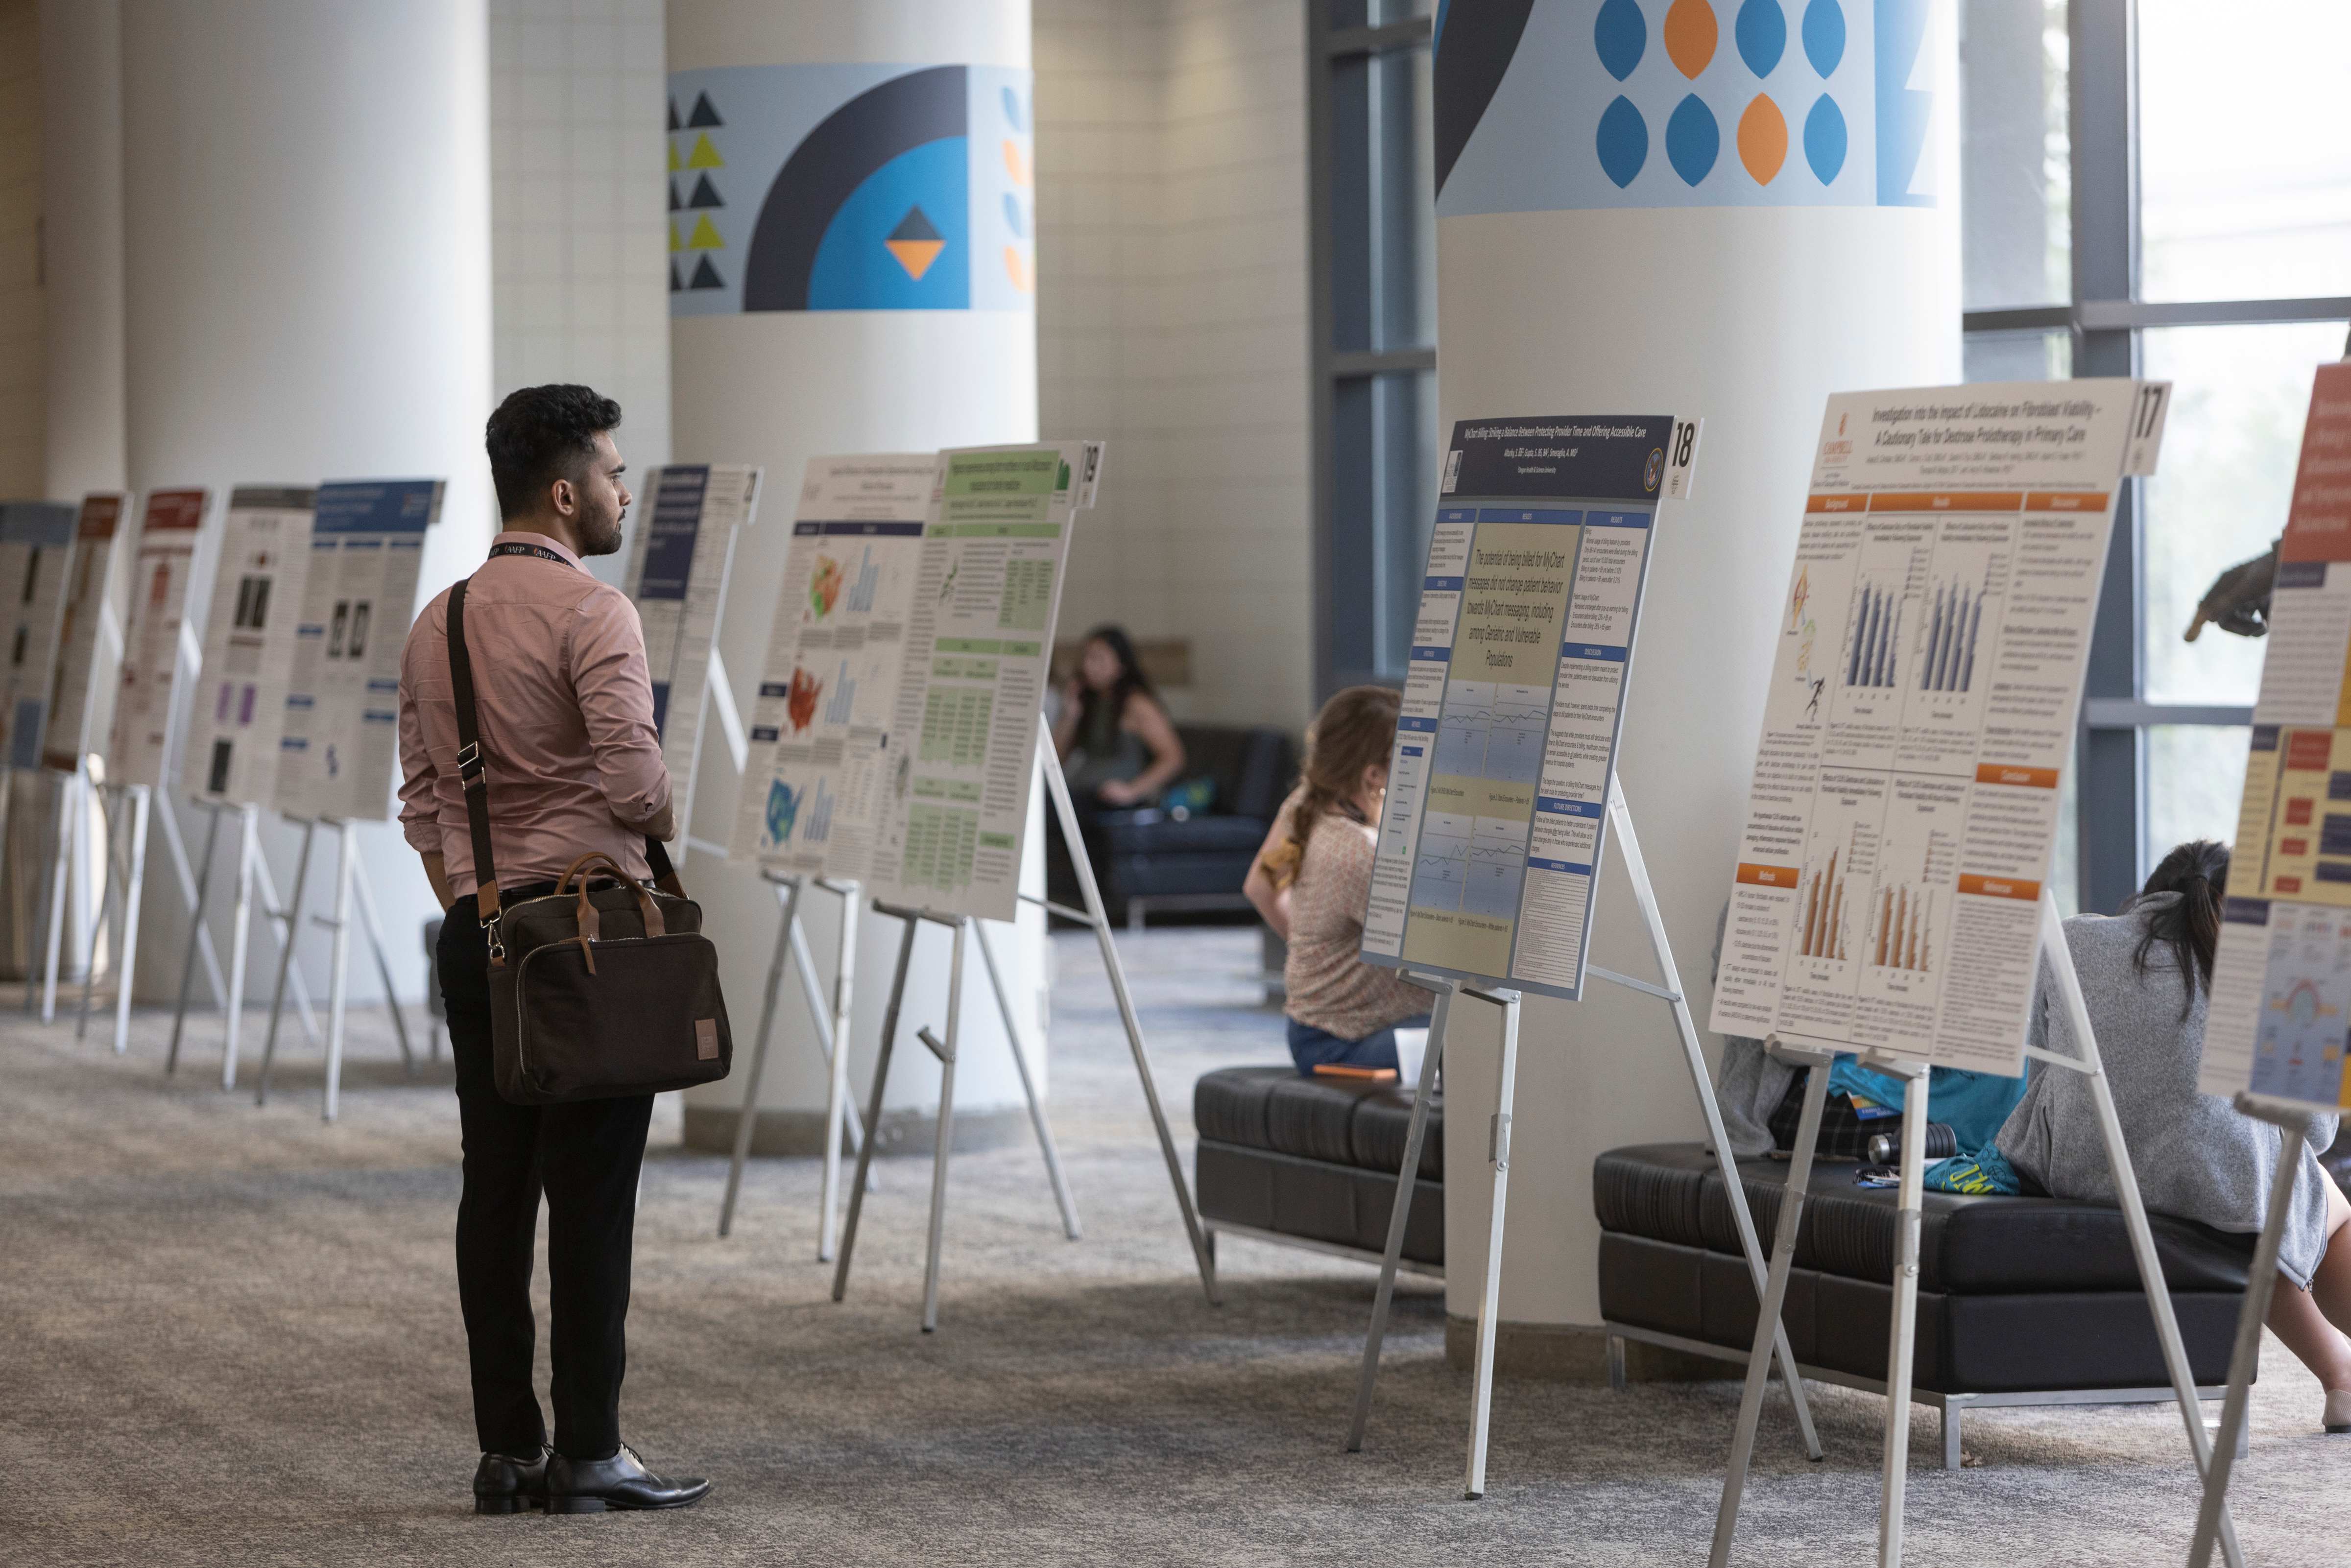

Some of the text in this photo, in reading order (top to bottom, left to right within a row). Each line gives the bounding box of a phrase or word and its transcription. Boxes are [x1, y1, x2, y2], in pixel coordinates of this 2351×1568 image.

[1871, 407, 1913, 425] Investigation
[2136, 385, 2164, 439] 17
[1464, 427, 1478, 440] MyChart
[1478, 427, 1488, 440] Billing:
[1489, 427, 1502, 440] Striking
[1505, 426, 1518, 437] Balance
[1519, 426, 1535, 437] Between
[1535, 426, 1554, 439] Protecting
[1555, 425, 1572, 437] Provider
[1572, 426, 1582, 437] Time
[1583, 426, 1592, 437] and
[1592, 426, 1610, 439] Offering
[1610, 426, 1634, 438] Accessible
[1634, 426, 1646, 438] Care
[2065, 424, 2087, 442] Care
[1672, 422, 1695, 468] 18
[535, 549, 556, 560] AAFP
[1475, 549, 1484, 564] The
[1483, 550, 1503, 569] potential
[1503, 550, 1509, 565] of
[1508, 551, 1521, 570] being
[1522, 551, 1535, 566] billed
[1542, 552, 1565, 571] MyChart
[1467, 577, 1489, 594] messages
[1505, 575, 1523, 595] change
[1523, 577, 1540, 595] patient
[1540, 577, 1563, 594] behavior
[1466, 599, 1554, 622] towards MyChart messaging, including
[1468, 624, 1541, 643] among Geriatric and Vulnerable
[1485, 650, 1513, 670] Populations
[1543, 827, 1552, 835] changes
[1565, 840, 1579, 848] experienced
